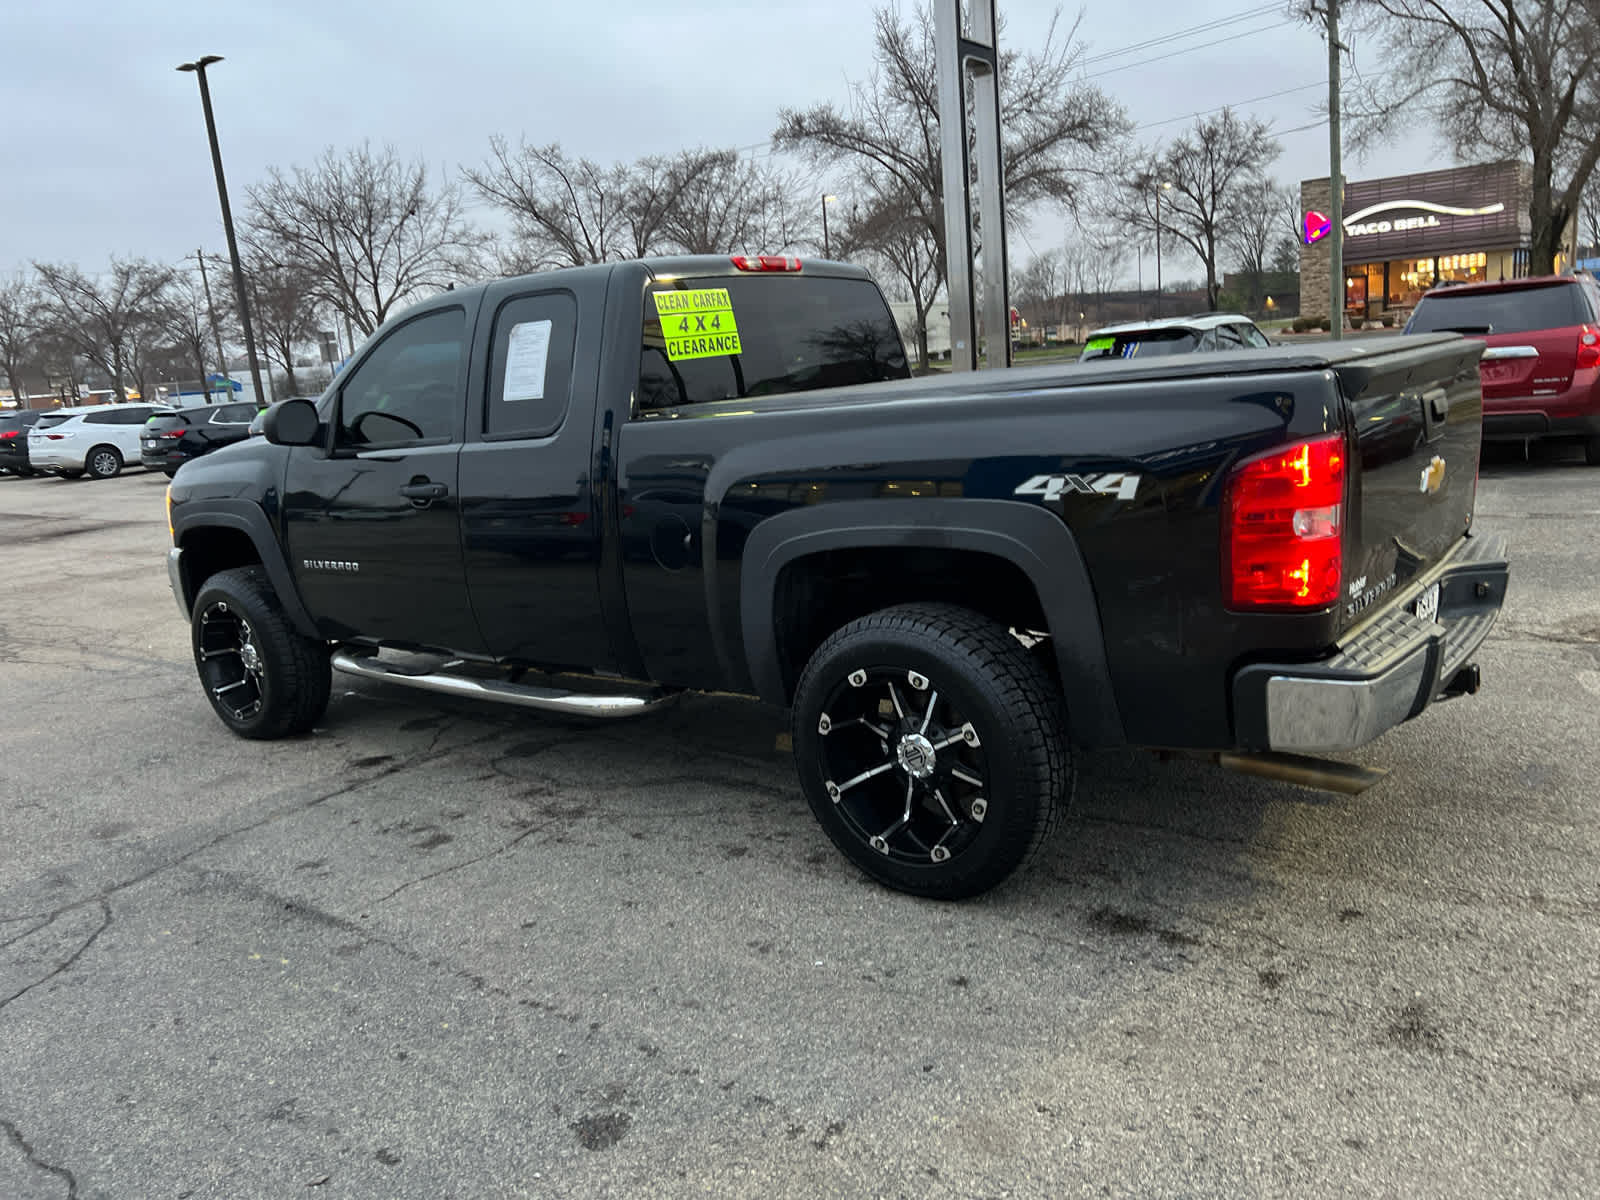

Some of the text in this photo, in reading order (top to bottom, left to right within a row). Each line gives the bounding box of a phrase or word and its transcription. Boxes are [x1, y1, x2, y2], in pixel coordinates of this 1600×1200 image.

[1345, 215, 1440, 236] TACO BELL
[657, 291, 730, 311] CLEAN CARFAX
[668, 335, 739, 357] CLEARANCE
[303, 559, 360, 572] SILVERADO
